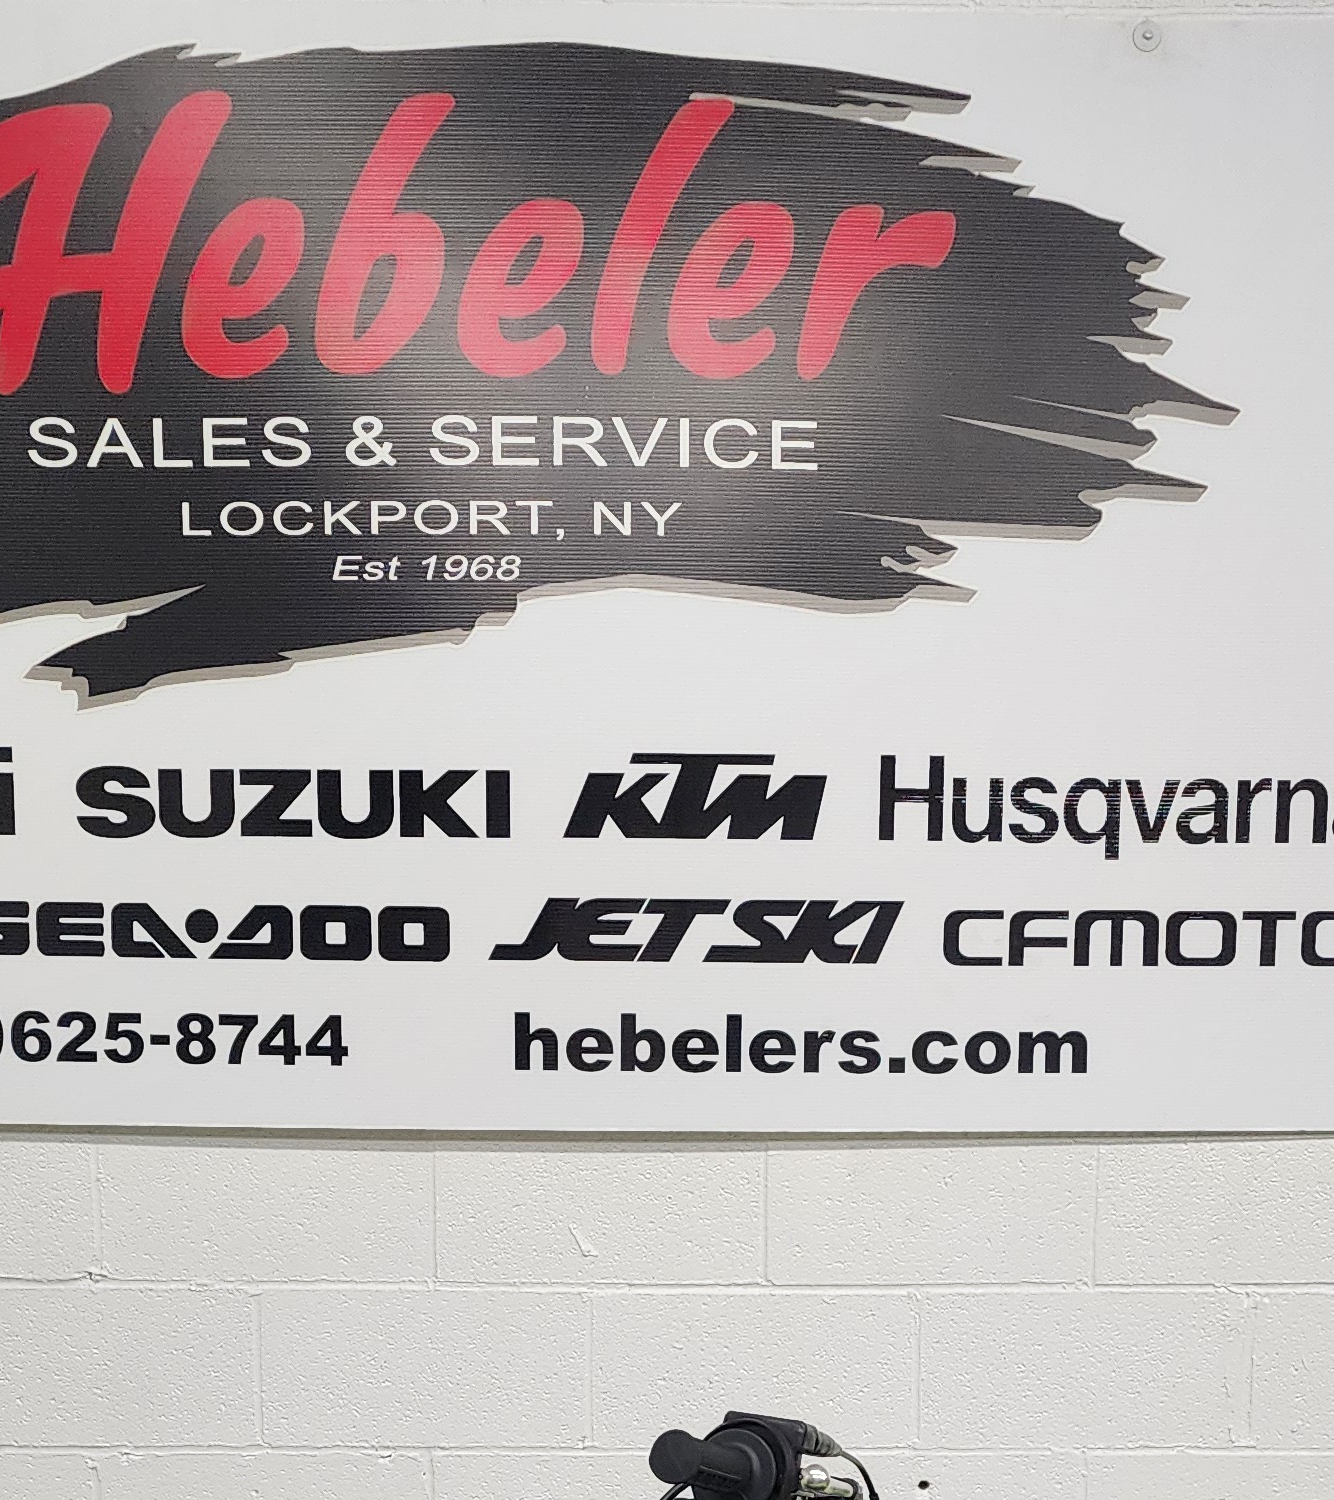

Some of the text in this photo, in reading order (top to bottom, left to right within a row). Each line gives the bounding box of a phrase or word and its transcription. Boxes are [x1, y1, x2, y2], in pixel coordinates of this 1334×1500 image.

[28, 415, 820, 471] SALES & SERVICE
[181, 499, 683, 541] LOCKPORT, NY
[332, 554, 522, 582] Est 1968
[75, 765, 511, 840] SUZUKI
[562, 752, 828, 841] KTM
[514, 1011, 1088, 1075] hebelers.com
